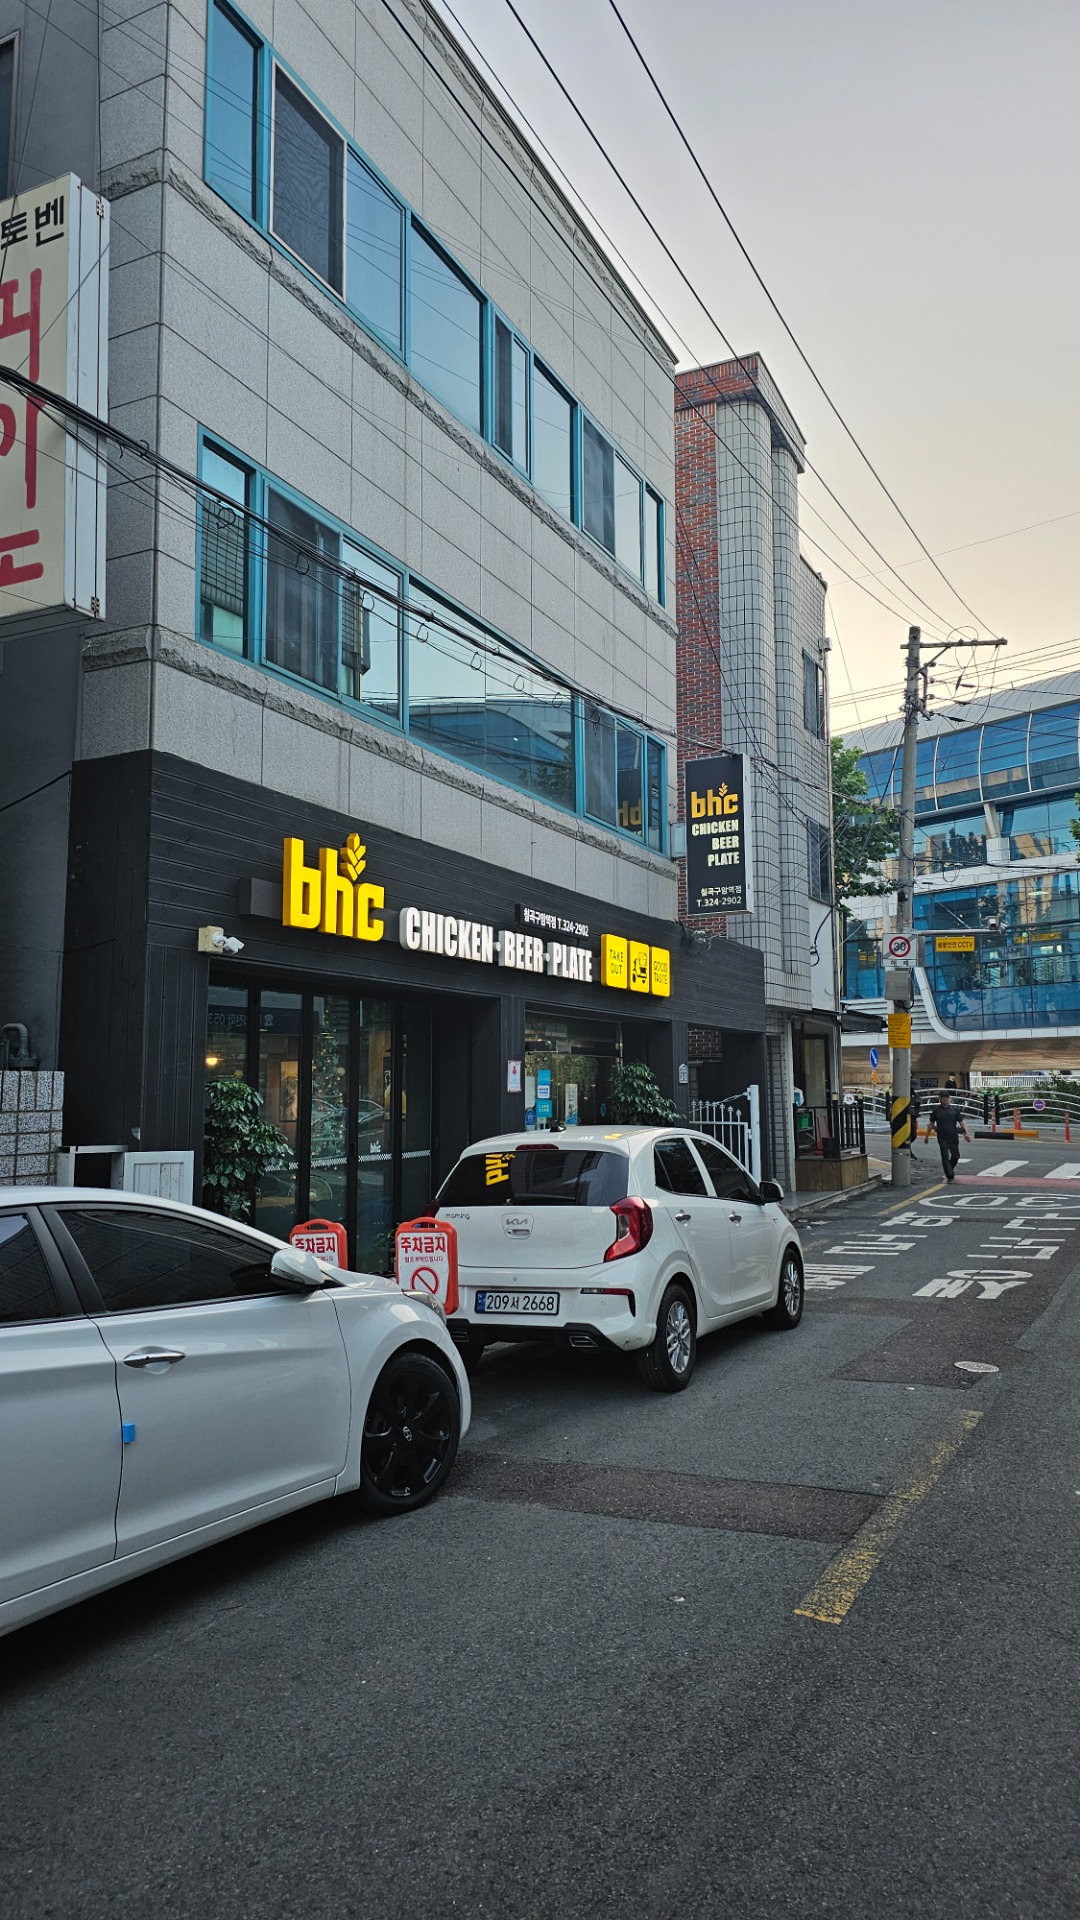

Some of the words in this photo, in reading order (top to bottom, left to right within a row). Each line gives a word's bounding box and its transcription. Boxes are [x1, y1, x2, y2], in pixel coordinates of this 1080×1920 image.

[690, 788, 739, 819] bhc
[691, 819, 739, 837] CHICKEN
[711, 835, 740, 851] BEER
[707, 851, 740, 867] PLATE
[283, 837, 384, 942] bhc
[696, 896, 742, 908] T.324-2902
[557, 917, 590, 937] T.324-2902
[400, 907, 494, 964] CHICKEN
[499, 930, 544, 974] BEER
[547, 942, 593, 983] PLATE
[893, 942, 907, 951] 30
[609, 949, 624, 962] TAKE
[610, 963, 623, 975] OUT
[653, 960, 668, 973] GOOD
[653, 972, 668, 985] TASTE
[445, 1212, 470, 1220] morning
[295, 1236, 336, 1254] 주차금지
[400, 1236, 446, 1254] 주차금지
[486, 1295, 520, 1311] 209서
[522, 1296, 555, 1311] 2668
